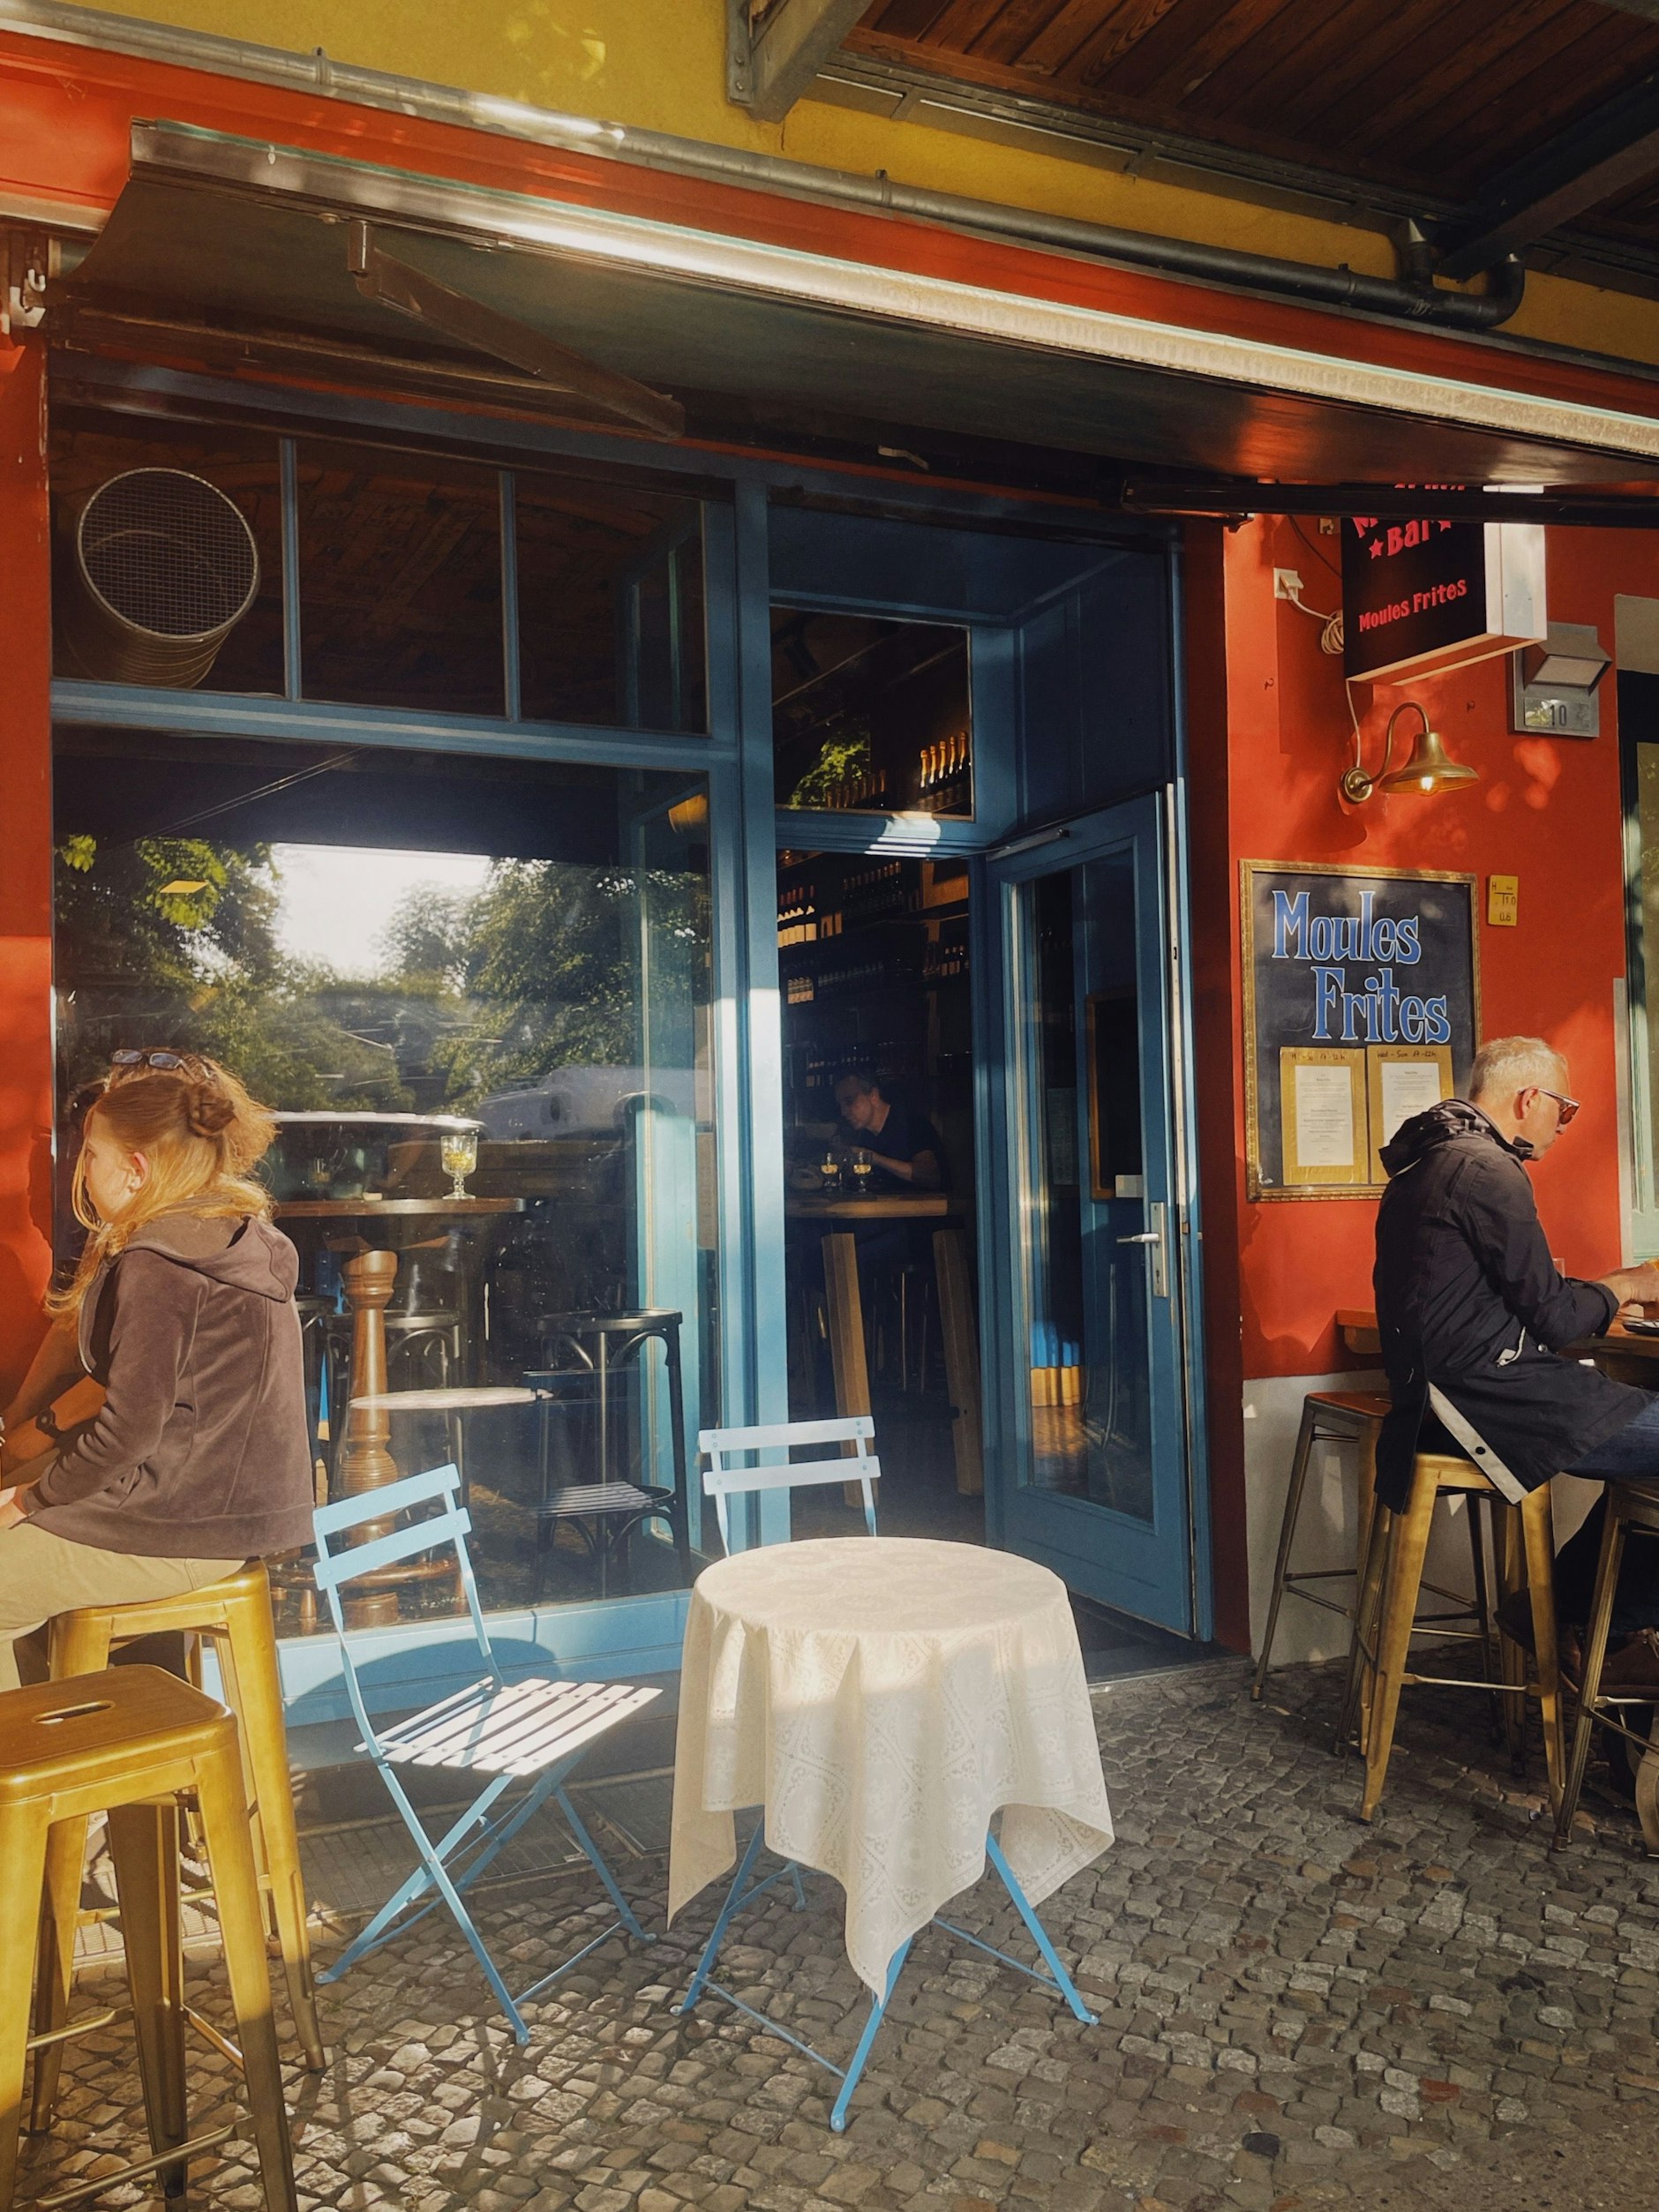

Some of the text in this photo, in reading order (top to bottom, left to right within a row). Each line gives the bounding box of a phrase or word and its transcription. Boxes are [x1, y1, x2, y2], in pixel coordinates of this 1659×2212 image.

[1358, 579, 1468, 633] Moules Frites
[1550, 704, 1567, 726] 10
[1272, 889, 1422, 965] Moules
[1310, 966, 1452, 1045] Frites
